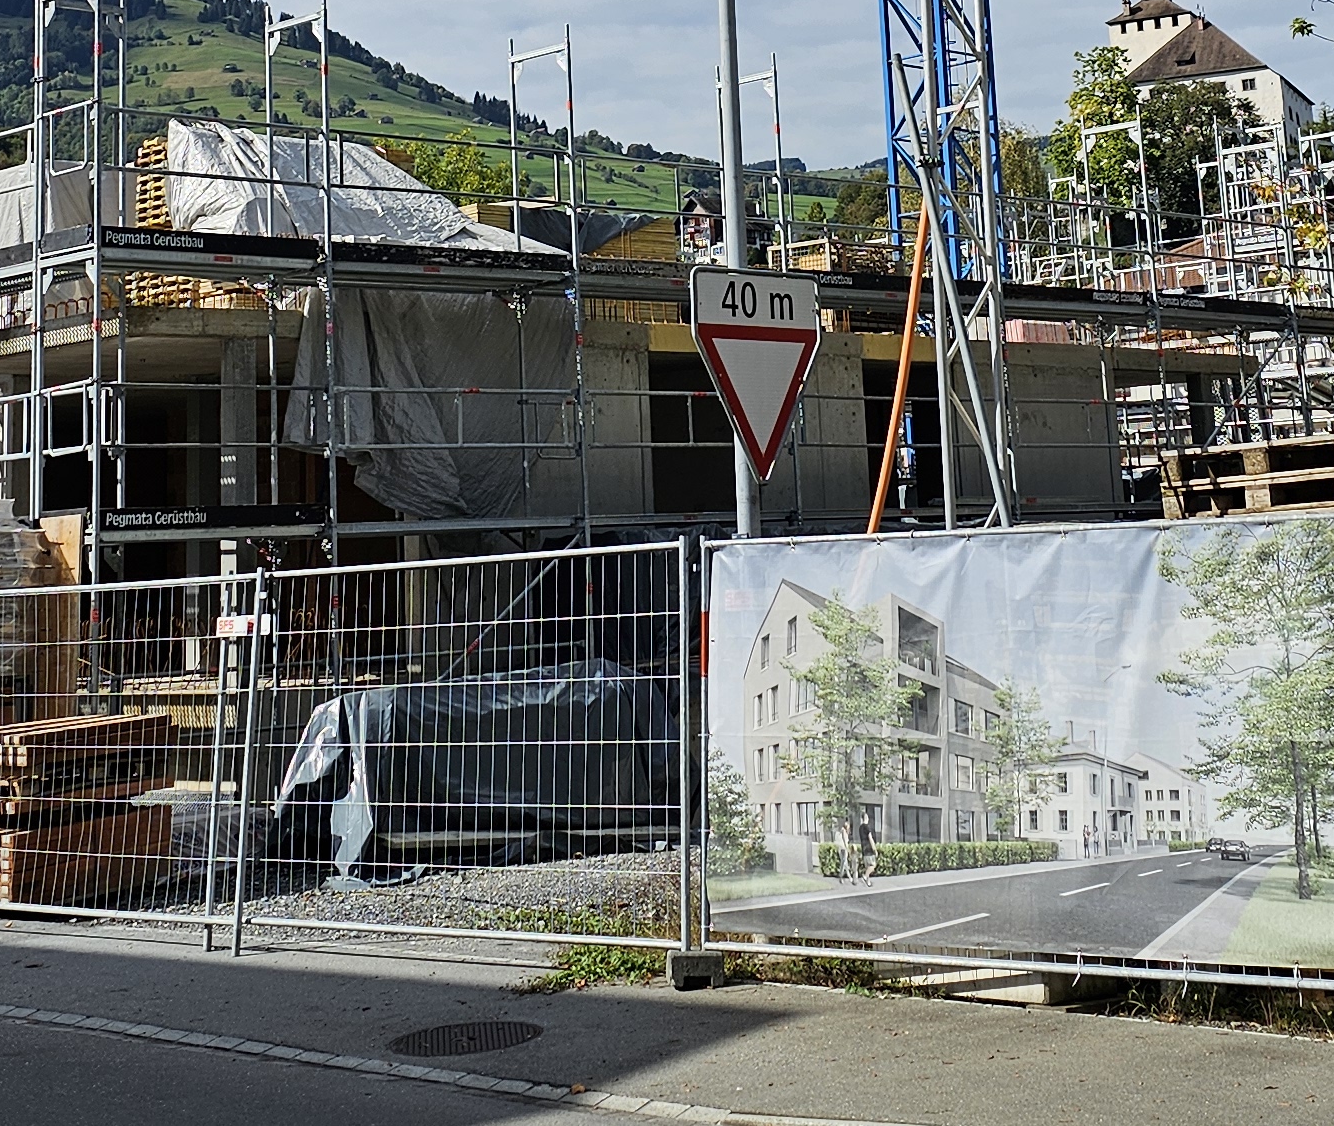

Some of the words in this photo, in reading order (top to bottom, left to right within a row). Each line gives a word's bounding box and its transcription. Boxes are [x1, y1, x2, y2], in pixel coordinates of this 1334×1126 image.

[105, 230, 151, 246] Pegmata
[153, 233, 204, 248] Gerüstbau
[721, 280, 758, 319] 40
[769, 291, 794, 321] m
[105, 511, 153, 528] Pegmata
[154, 510, 207, 524] Gerüstbau
[219, 619, 235, 631] SFS
